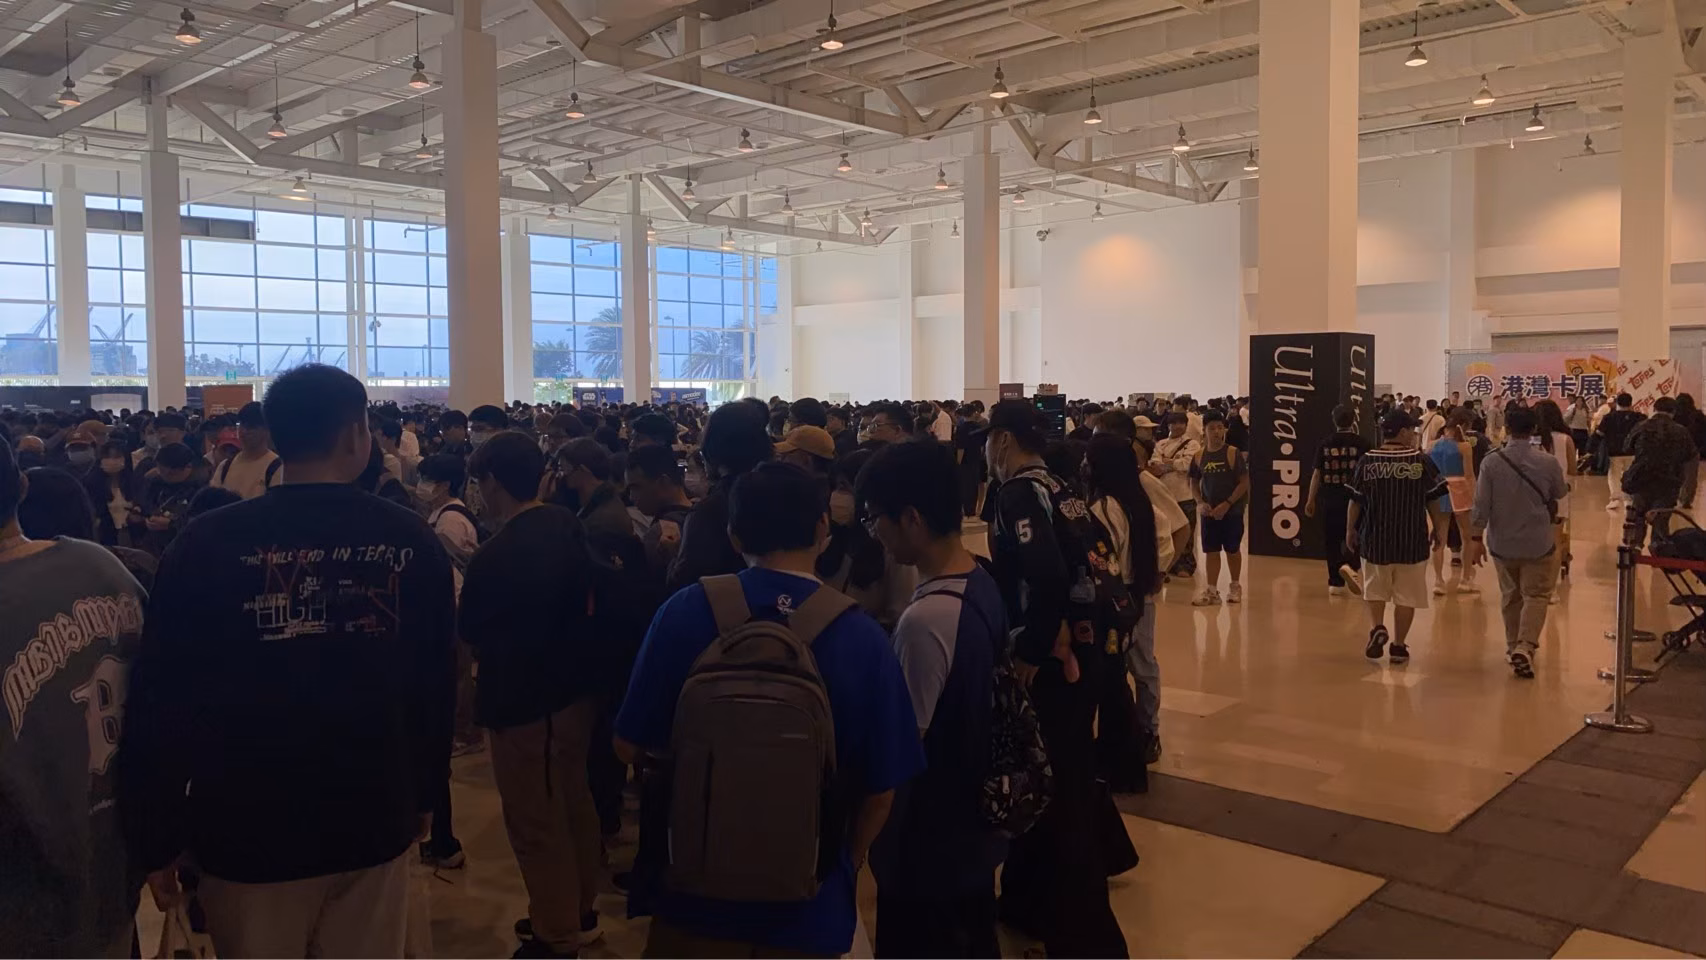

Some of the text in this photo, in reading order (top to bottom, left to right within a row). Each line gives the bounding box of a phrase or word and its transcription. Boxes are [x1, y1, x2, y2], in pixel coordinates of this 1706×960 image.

[1501, 374, 1606, 399] 港灣卡展
[1272, 344, 1315, 540] Ultra PRO
[1363, 461, 1425, 481] KWCS
[1015, 517, 1032, 544] 5
[332, 547, 351, 562] IN
